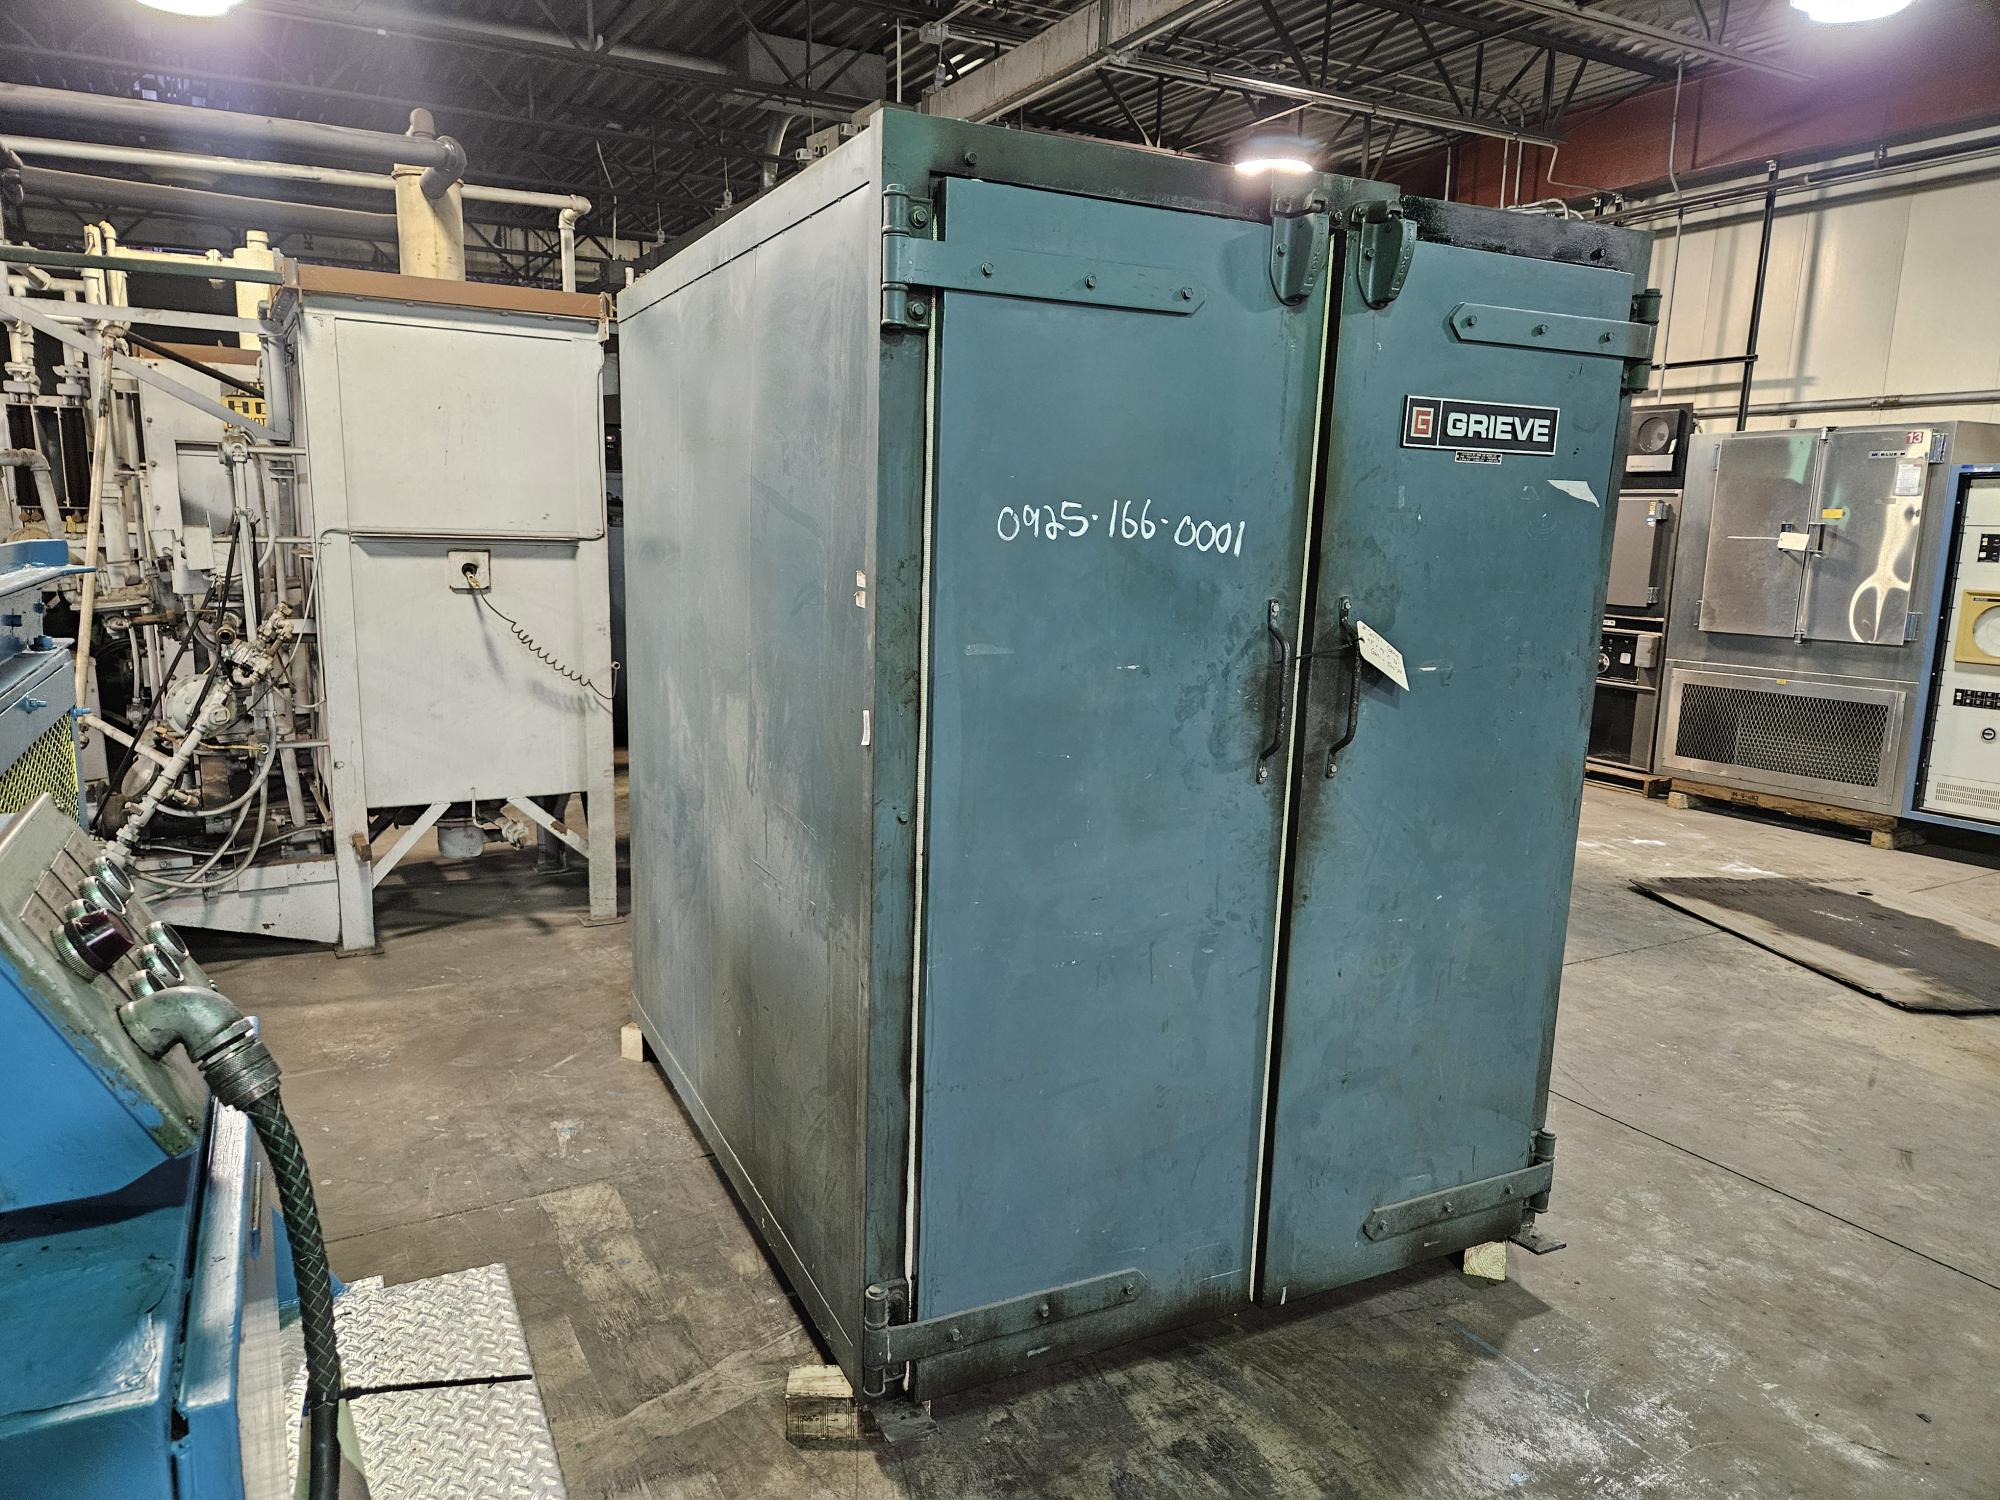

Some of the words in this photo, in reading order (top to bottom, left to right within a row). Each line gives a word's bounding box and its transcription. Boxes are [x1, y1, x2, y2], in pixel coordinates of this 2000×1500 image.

[1411, 407, 1432, 437] G
[1447, 413, 1551, 442] GRIEVE
[1908, 432, 1922, 443] 13
